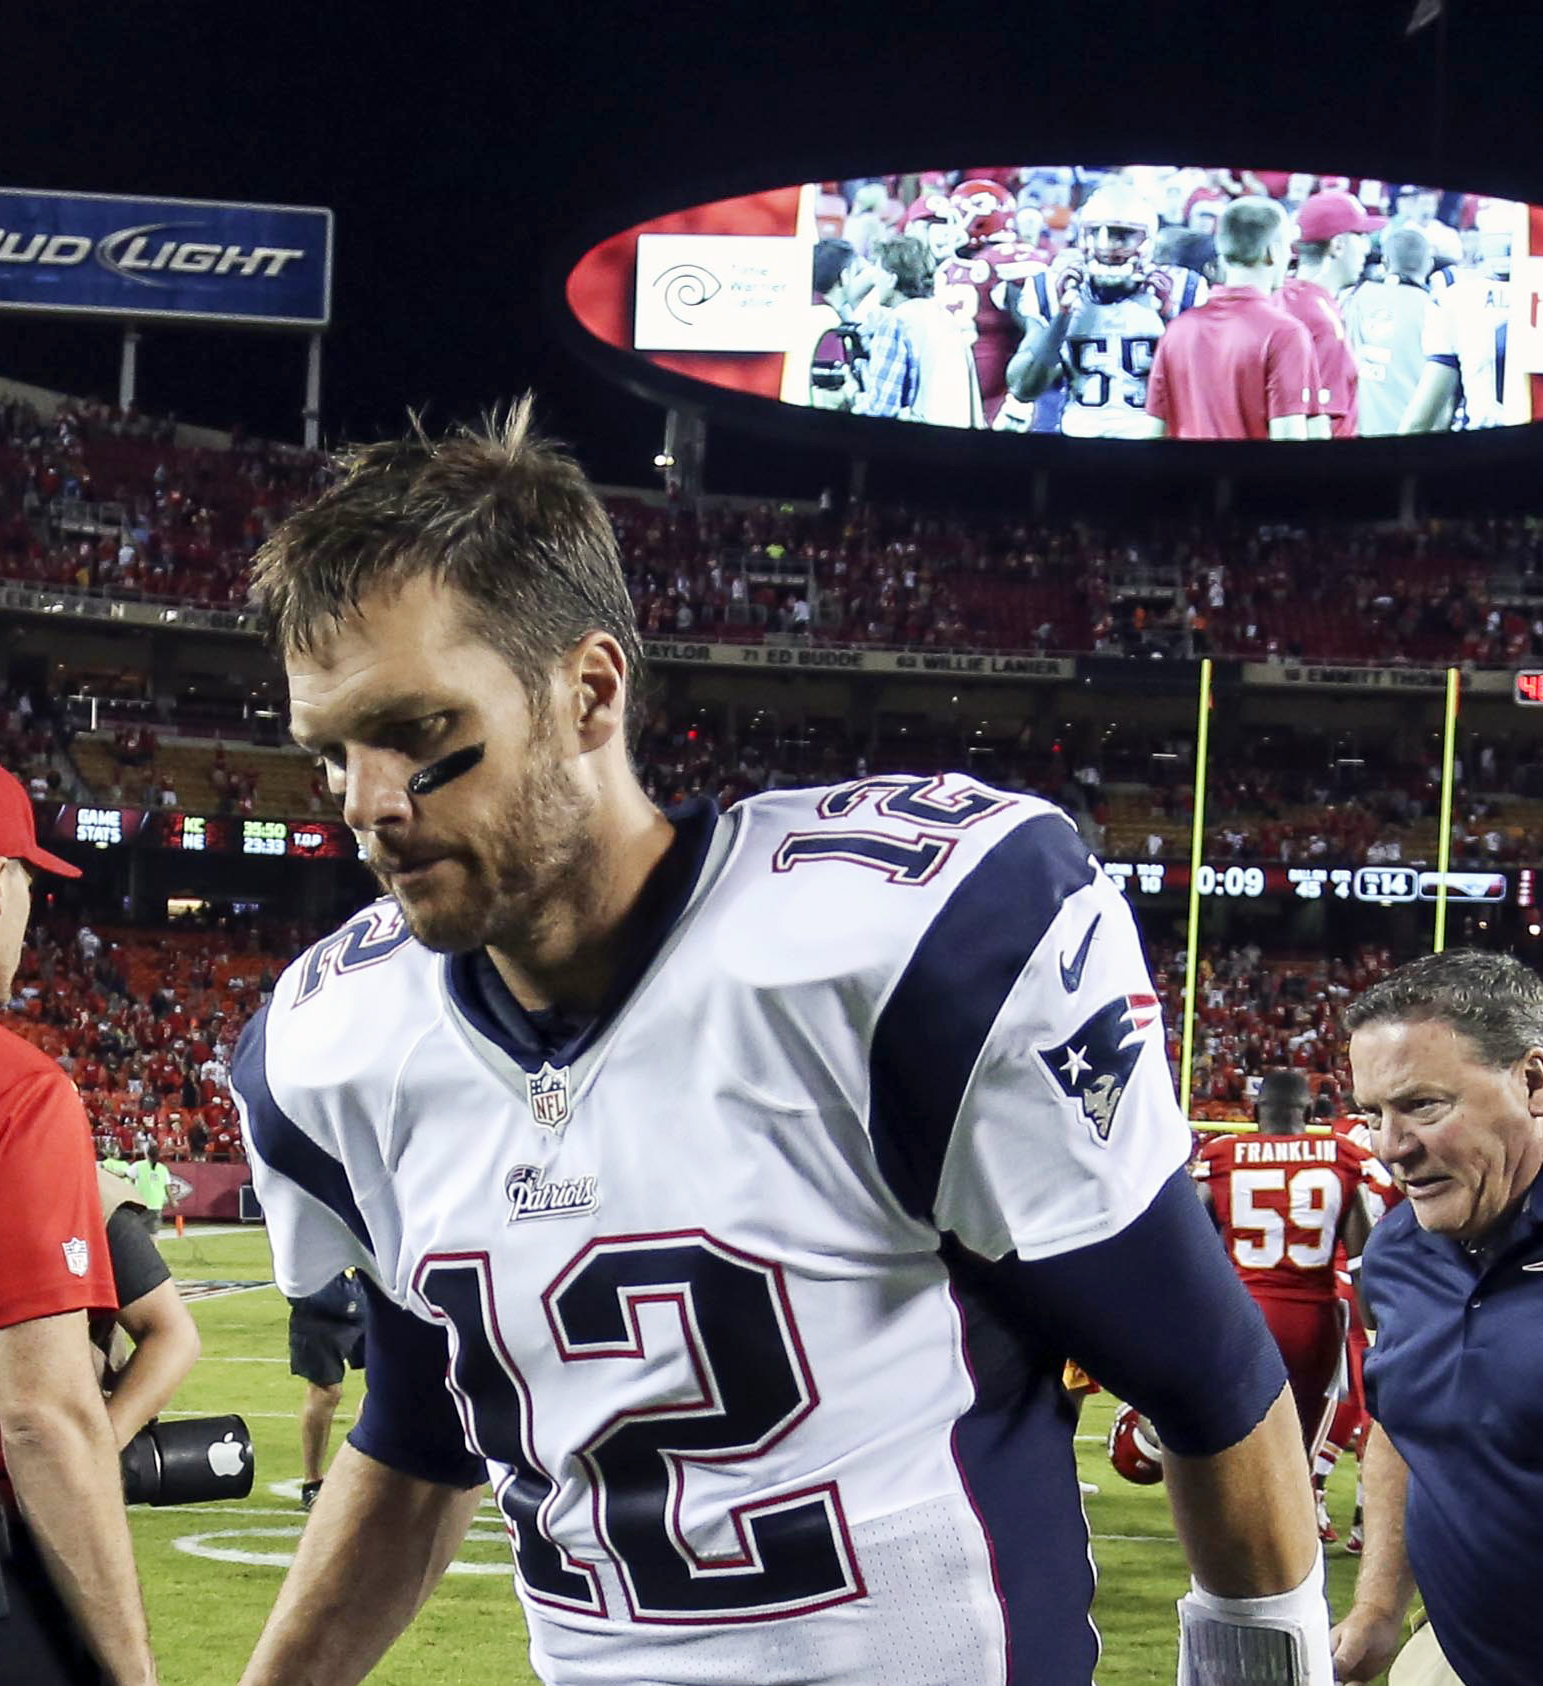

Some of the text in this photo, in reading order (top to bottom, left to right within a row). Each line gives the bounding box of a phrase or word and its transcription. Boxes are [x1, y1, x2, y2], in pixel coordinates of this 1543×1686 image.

[116, 235, 305, 278] LIGHT
[1394, 669, 1472, 688] THOMS
[76, 808, 122, 828] GAME
[771, 771, 1020, 887] 12
[76, 825, 122, 844] STATS
[182, 833, 206, 851] NE
[1196, 865, 1265, 898] 0:09
[1380, 872, 1408, 897] 14
[290, 893, 414, 1009] 2
[534, 1093, 565, 1122] NFL
[1233, 1139, 1338, 1164] FRANKLIN
[507, 1176, 596, 1222] Patriots
[1229, 1167, 1343, 1270] 59
[411, 1227, 869, 1625] 12
